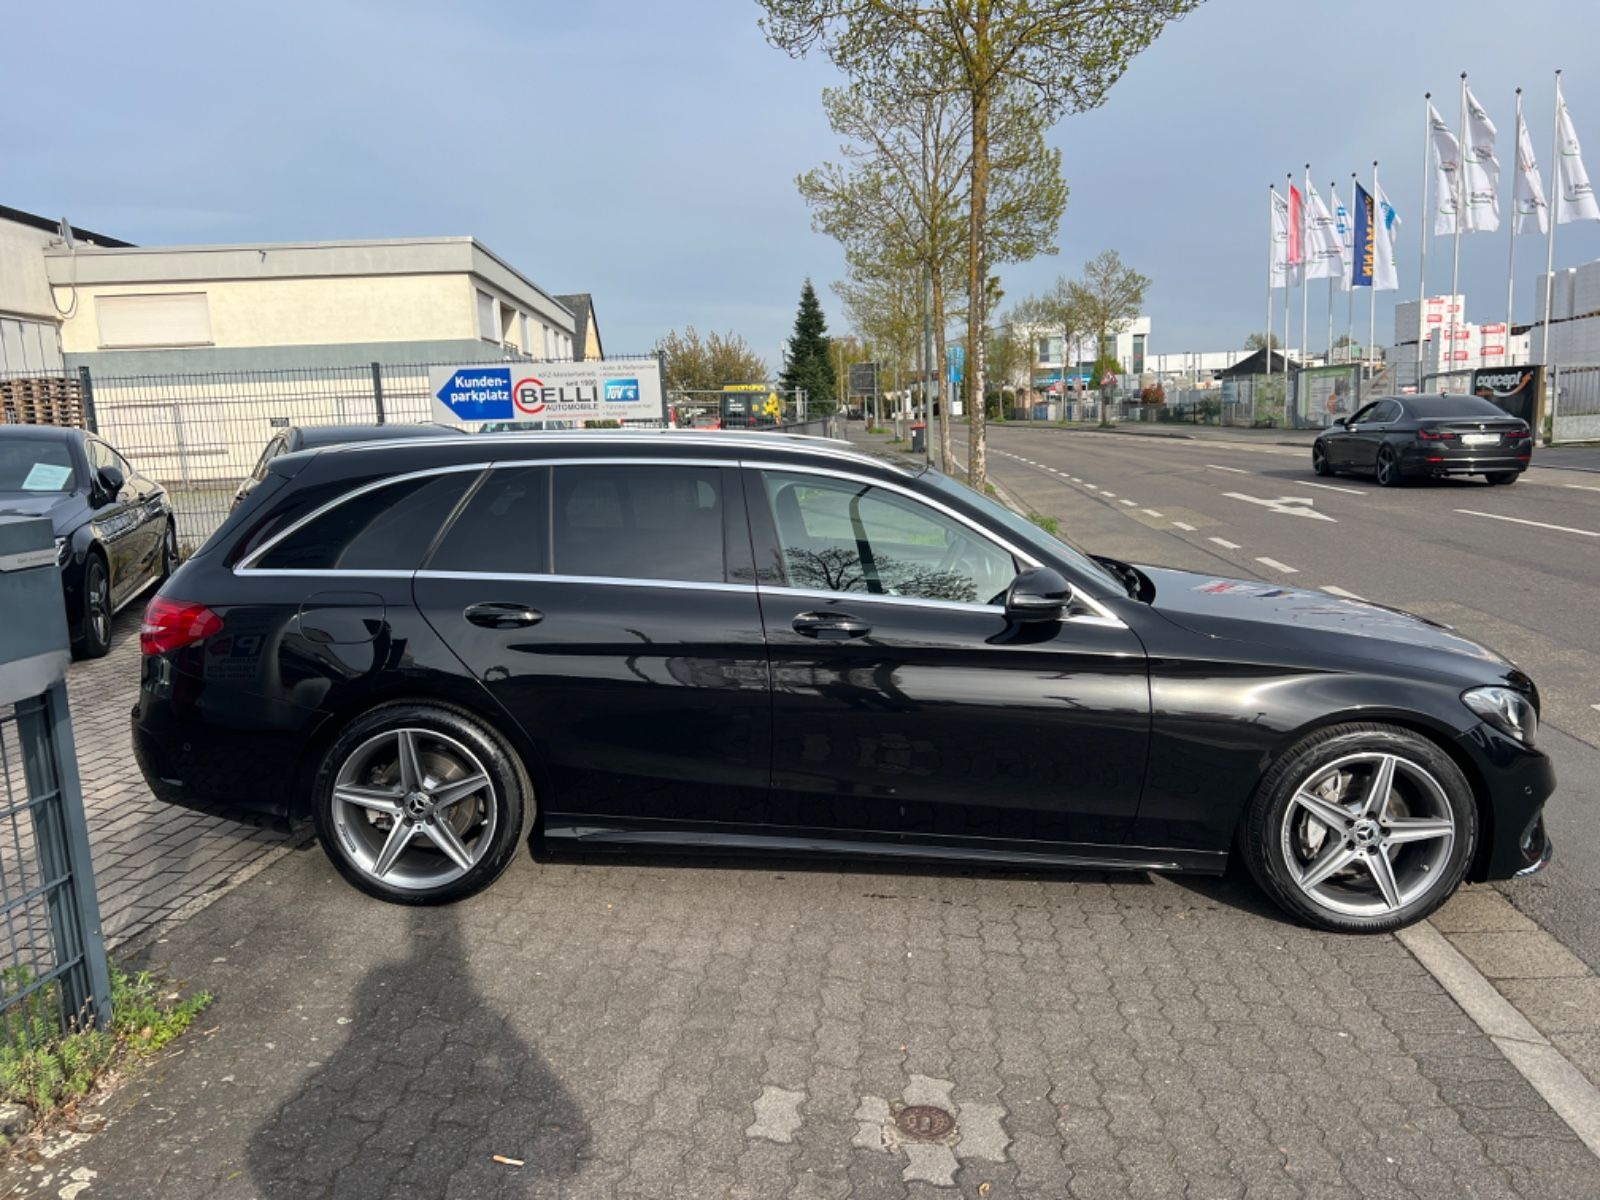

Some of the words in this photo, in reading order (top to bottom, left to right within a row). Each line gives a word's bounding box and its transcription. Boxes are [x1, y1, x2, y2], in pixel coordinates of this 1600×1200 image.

[455, 376, 508, 388] Kunden-
[1476, 371, 1522, 389] concept
[450, 389, 509, 405] parkplatz
[520, 386, 598, 404] BELLI
[545, 403, 598, 412] AUTOMOBILE
